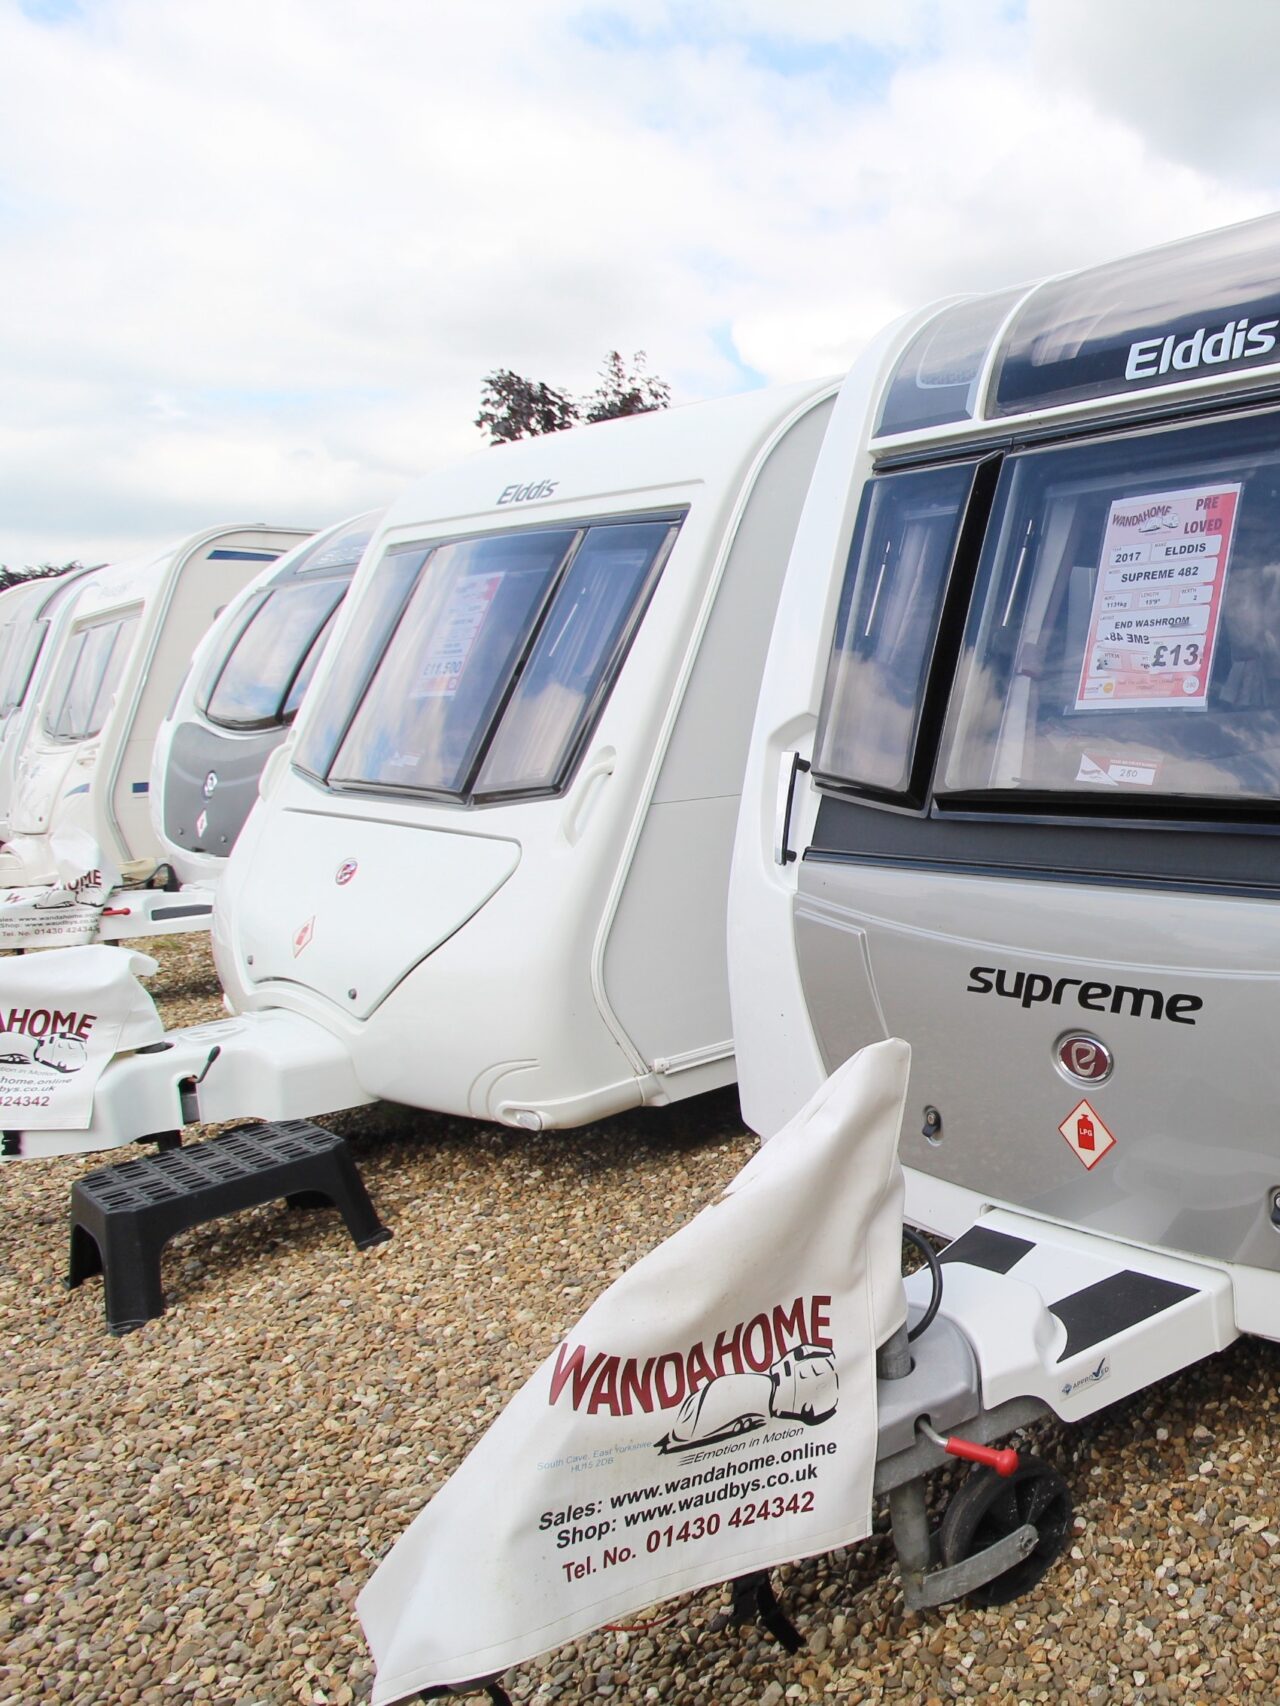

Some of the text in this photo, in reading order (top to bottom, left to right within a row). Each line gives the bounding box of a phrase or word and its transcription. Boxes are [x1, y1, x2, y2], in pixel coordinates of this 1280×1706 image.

[1125, 319, 1279, 381] Elddis
[496, 479, 560, 505] Elddis
[1195, 496, 1219, 511] PRE
[1112, 505, 1172, 527] WANDAHOME
[1184, 518, 1222, 534] LOVED
[1115, 552, 1141, 563] 2017
[1165, 543, 1206, 556] ELDDIS
[1121, 566, 1199, 582] SUPREME 482
[1114, 616, 1190, 629] END WASHROOM
[967, 966, 1203, 1025] supreme
[1079, 1127, 1093, 1137] LPG
[549, 1296, 832, 1416] WANDAHOME
[693, 1427, 804, 1463] Emotion in Motion
[536, 1460, 564, 1471] South
[593, 1447, 612, 1457] East
[570, 1457, 614, 1473] HU15 2DB
[538, 1440, 838, 1531] Sales: www.wandahome.online
[556, 1464, 818, 1549] Shop: www.waudbys.co.uk
[562, 1490, 815, 1583] Tel. No. 01430 424342
